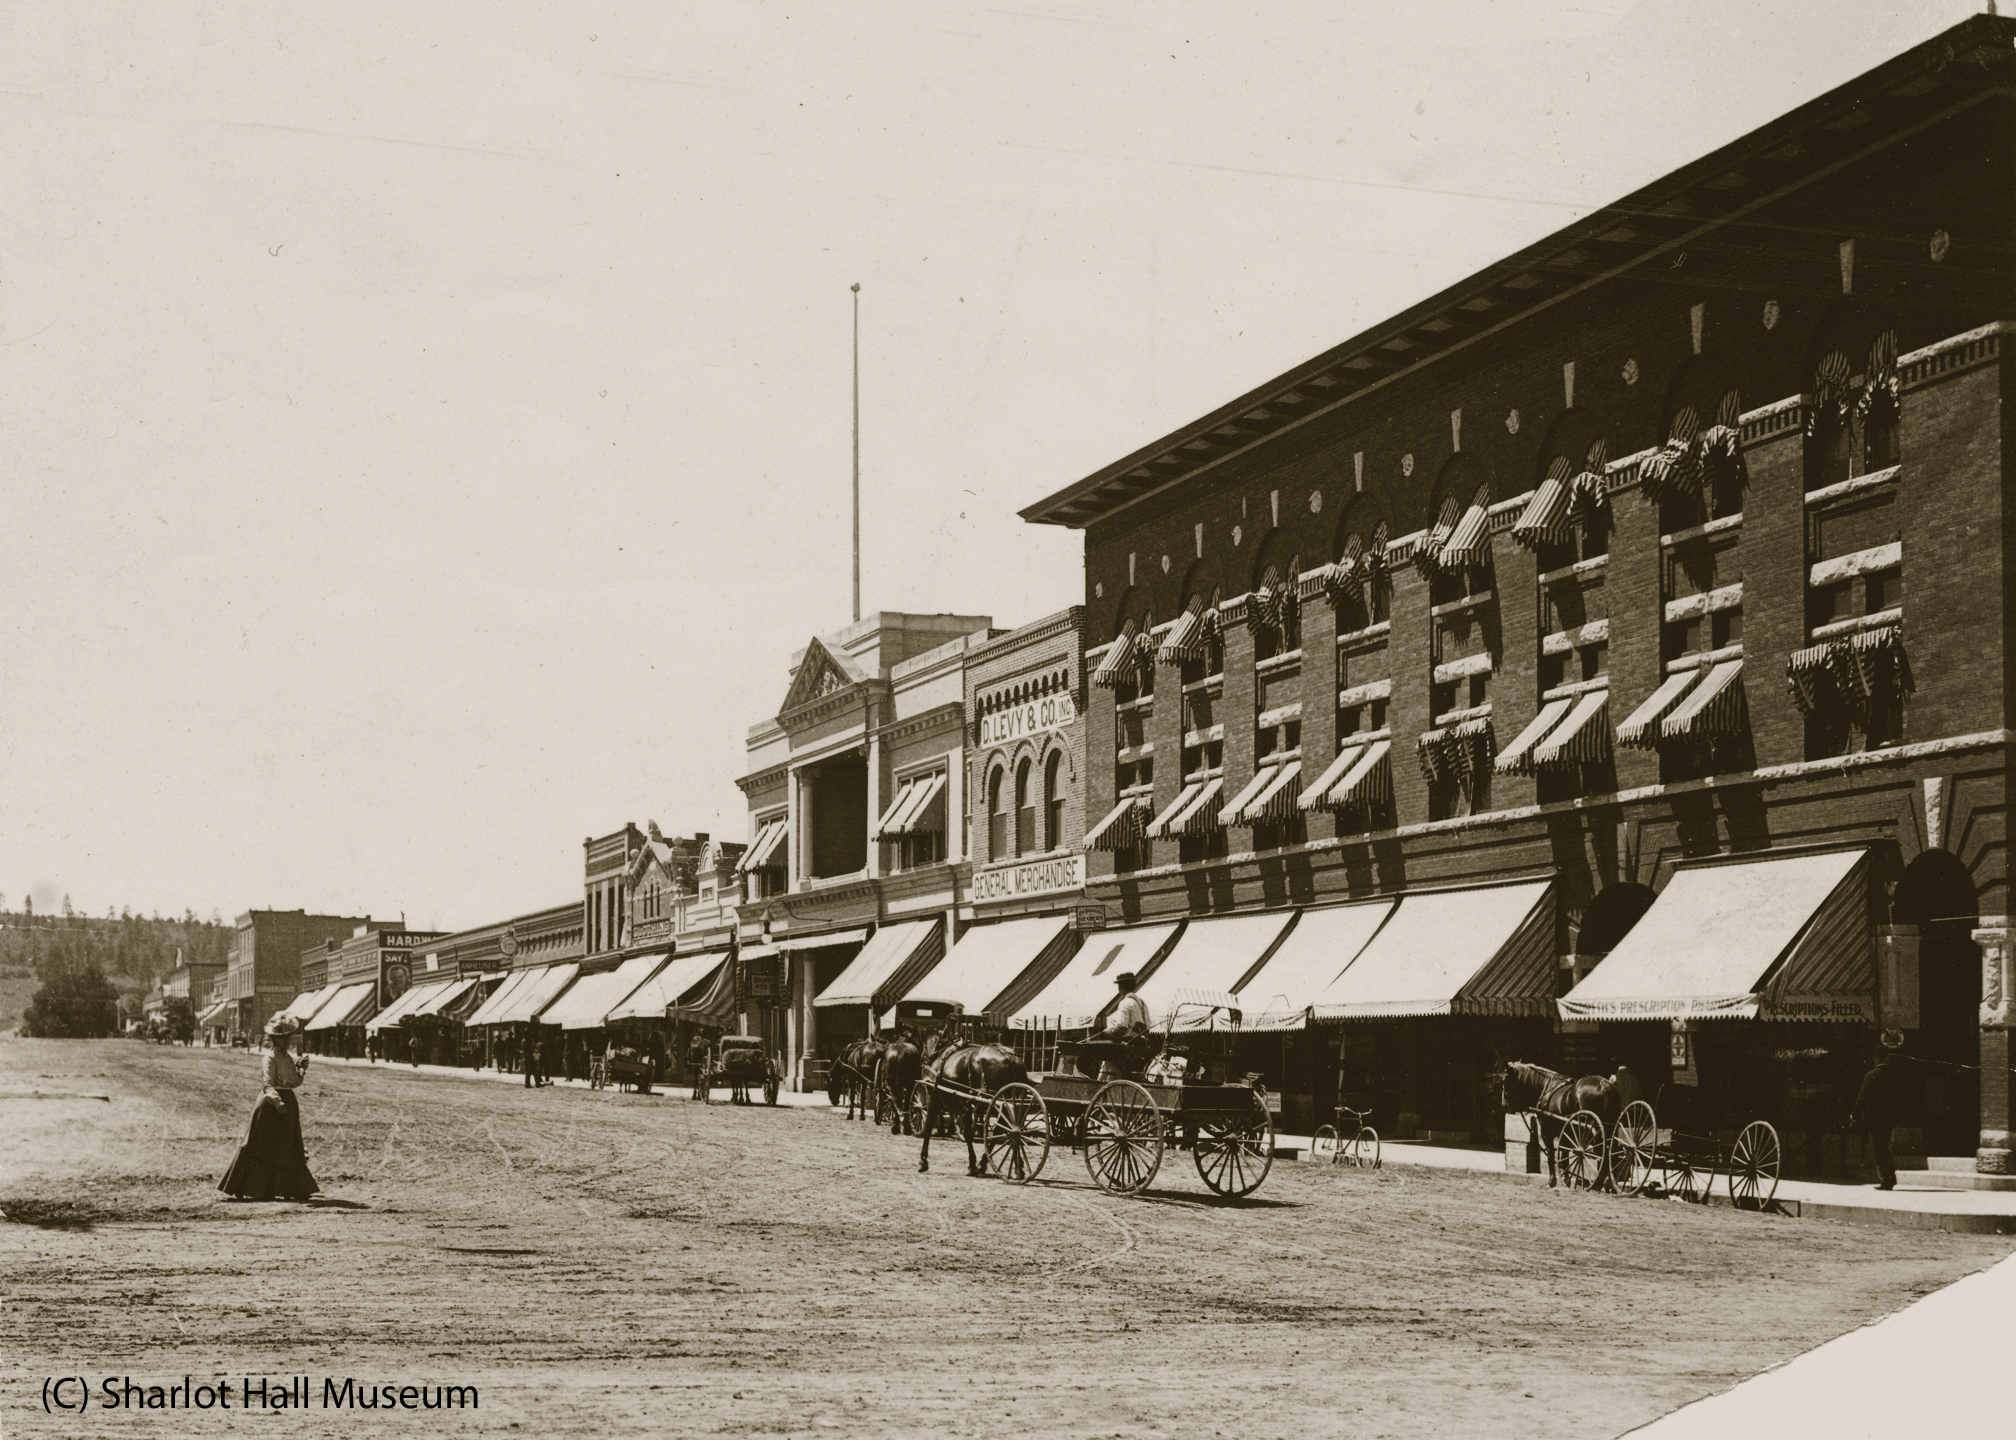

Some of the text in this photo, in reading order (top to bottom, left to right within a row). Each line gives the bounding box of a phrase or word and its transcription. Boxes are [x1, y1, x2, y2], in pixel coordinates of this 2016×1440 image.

[983, 719, 992, 745] D.
[993, 708, 1023, 741] LEVY
[1027, 705, 1036, 731] &
[1040, 699, 1058, 728] CO.
[974, 859, 1081, 900] GENERAL MERCHANDISE.
[633, 921, 670, 938] CLOTHING
[384, 953, 408, 963] SAY!
[460, 961, 498, 970] ANHEUSER
[1620, 999, 1685, 1014] PRESCRIPTION
[1763, 999, 1865, 1018] PRESCRIPTIONS FILLED.
